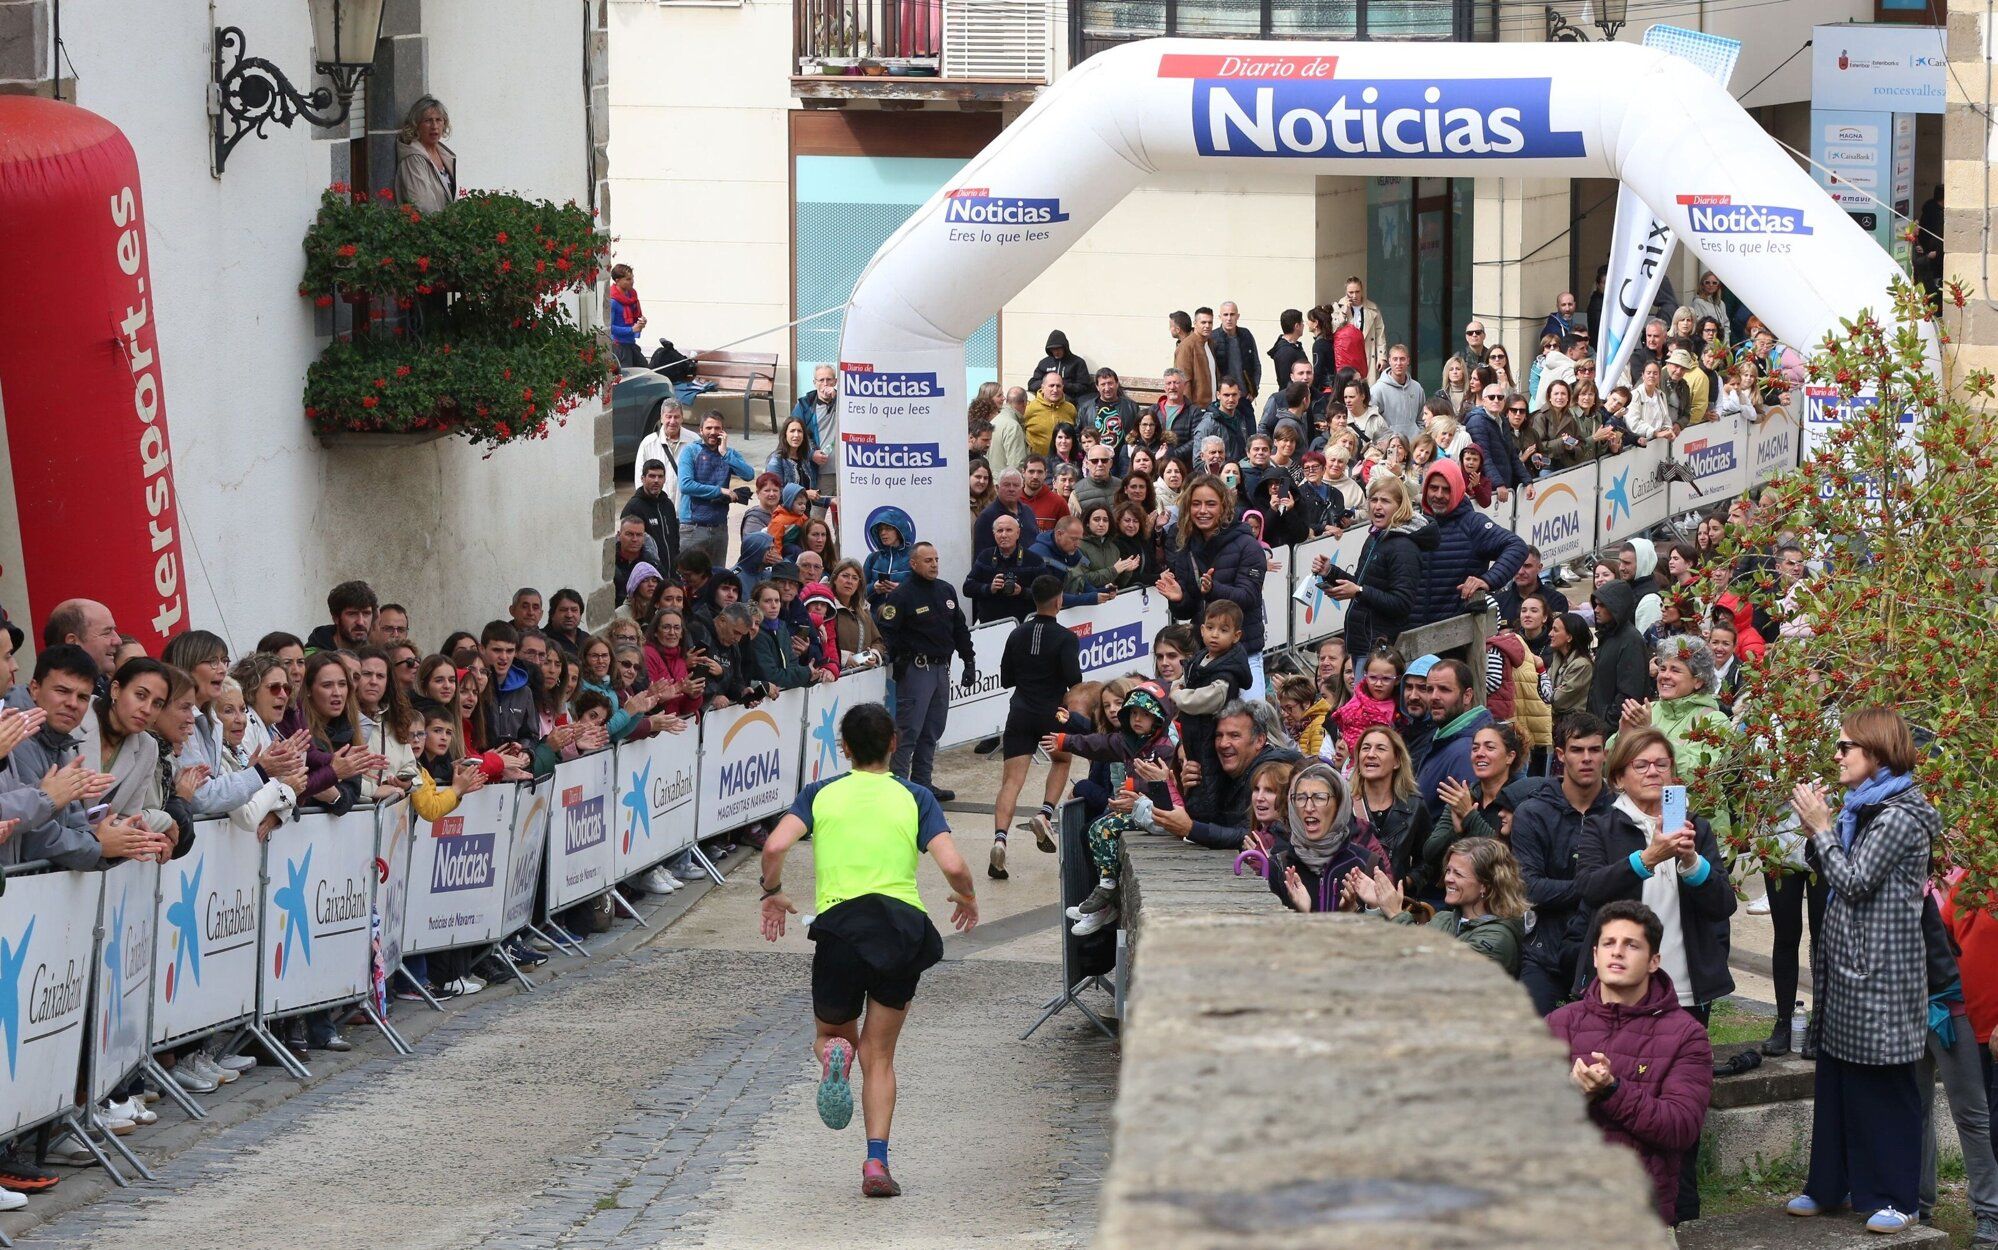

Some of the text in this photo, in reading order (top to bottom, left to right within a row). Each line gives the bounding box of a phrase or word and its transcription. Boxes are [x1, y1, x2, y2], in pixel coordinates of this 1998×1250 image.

[1217, 56, 1330, 78] Diario de
[1208, 86, 1526, 154] Noticias
[1840, 152, 1870, 160] CaixaBank
[957, 189, 987, 198] Diario de
[1693, 195, 1729, 205] Diario de
[949, 199, 1051, 223] Noticias
[1691, 207, 1795, 232] Noticias
[949, 228, 1049, 246] Eres lo que lees
[1700, 238, 1721, 252] Eres
[1726, 239, 1735, 252] lo
[1740, 242, 1761, 256] que
[847, 363, 873, 372] Diario de
[846, 374, 931, 396] Noticias
[1811, 387, 1836, 396] Diario de
[848, 401, 930, 418] Eres lo que lees
[848, 434, 874, 443] Diario de
[1757, 431, 1789, 465] MAGNA
[847, 444, 933, 467] Noticias
[1690, 446, 1731, 477] Noticias
[850, 472, 932, 489] Eres lo que lees
[1532, 510, 1579, 547] MAGNA
[1079, 631, 1136, 670] oticias
[950, 669, 1000, 701] ixaBan
[719, 748, 780, 800] MAGNA
[653, 764, 693, 809] CaixaBank
[717, 788, 779, 821] MAGNESITAS NAVARRAS
[567, 804, 602, 850] Noticias
[433, 841, 489, 889] Noticias
[316, 876, 367, 925] CaixaBank
[206, 884, 256, 942] CaixaBank
